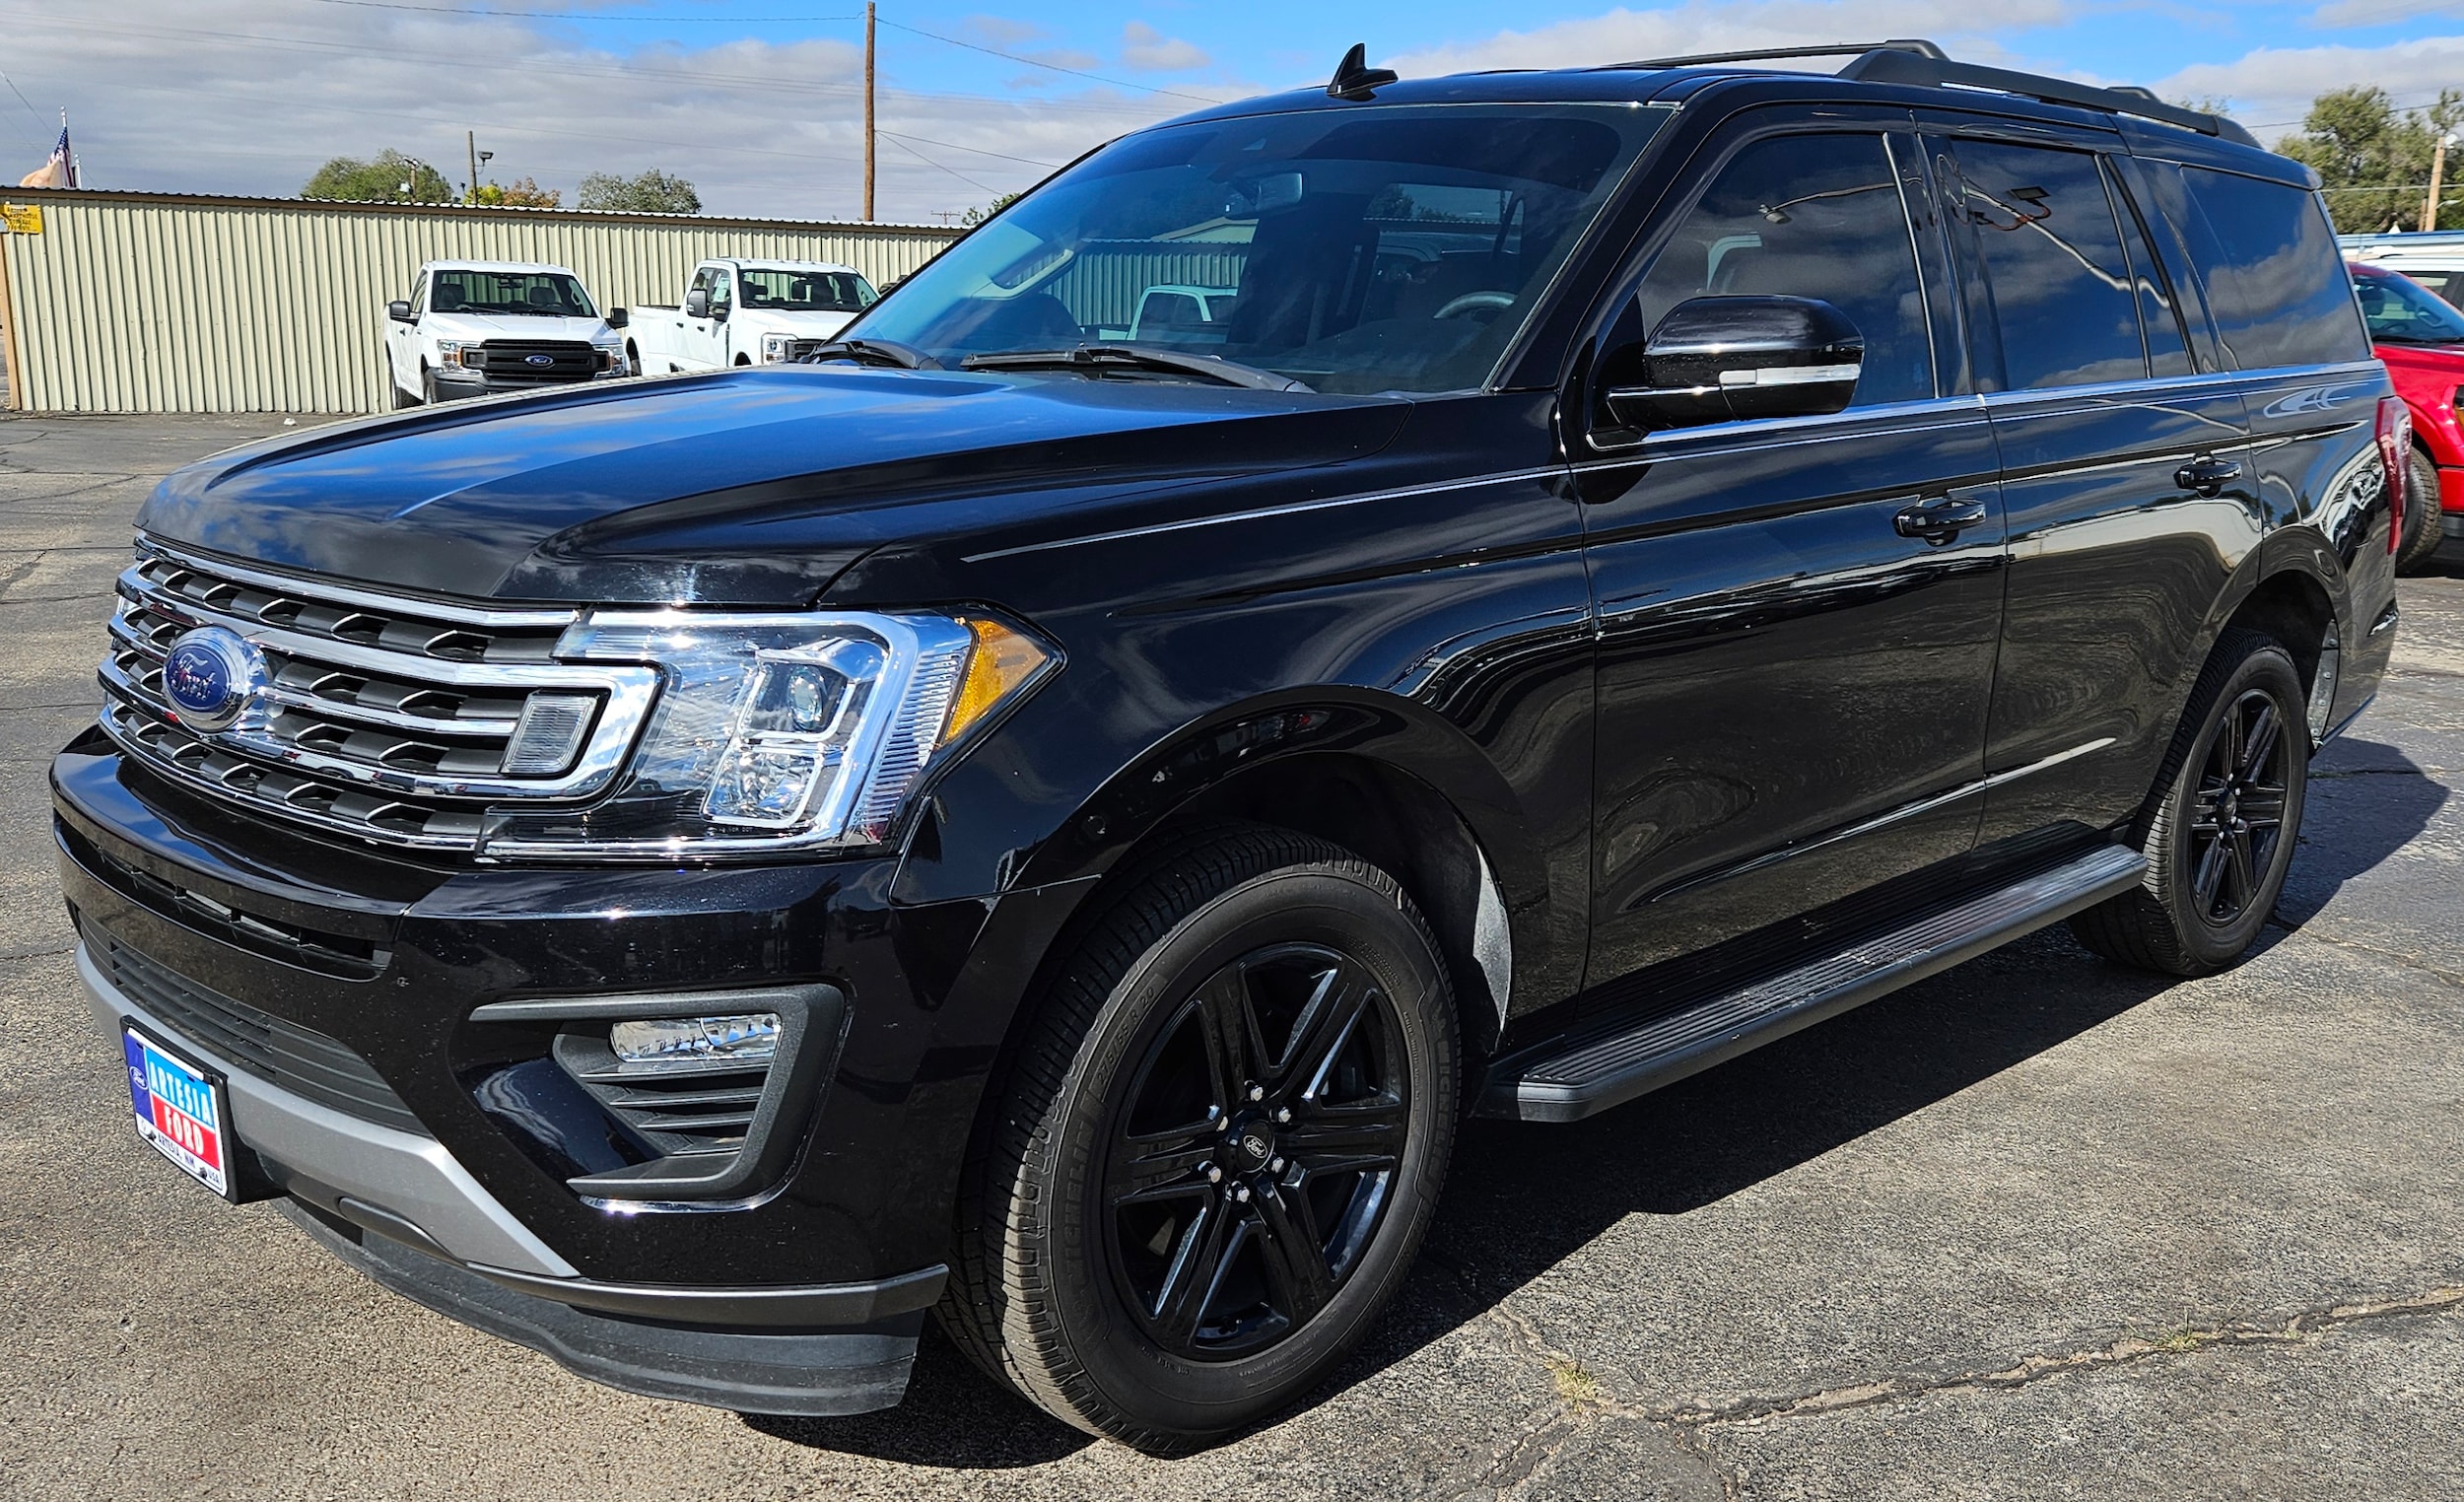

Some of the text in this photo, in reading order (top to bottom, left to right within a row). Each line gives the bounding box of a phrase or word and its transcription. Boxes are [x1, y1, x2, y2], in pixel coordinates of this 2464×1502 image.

[170, 652, 217, 701] Ford
[149, 1060, 215, 1127] ARTESIA
[164, 1103, 205, 1155] FORD
[1247, 1137, 1266, 1156] Ford
